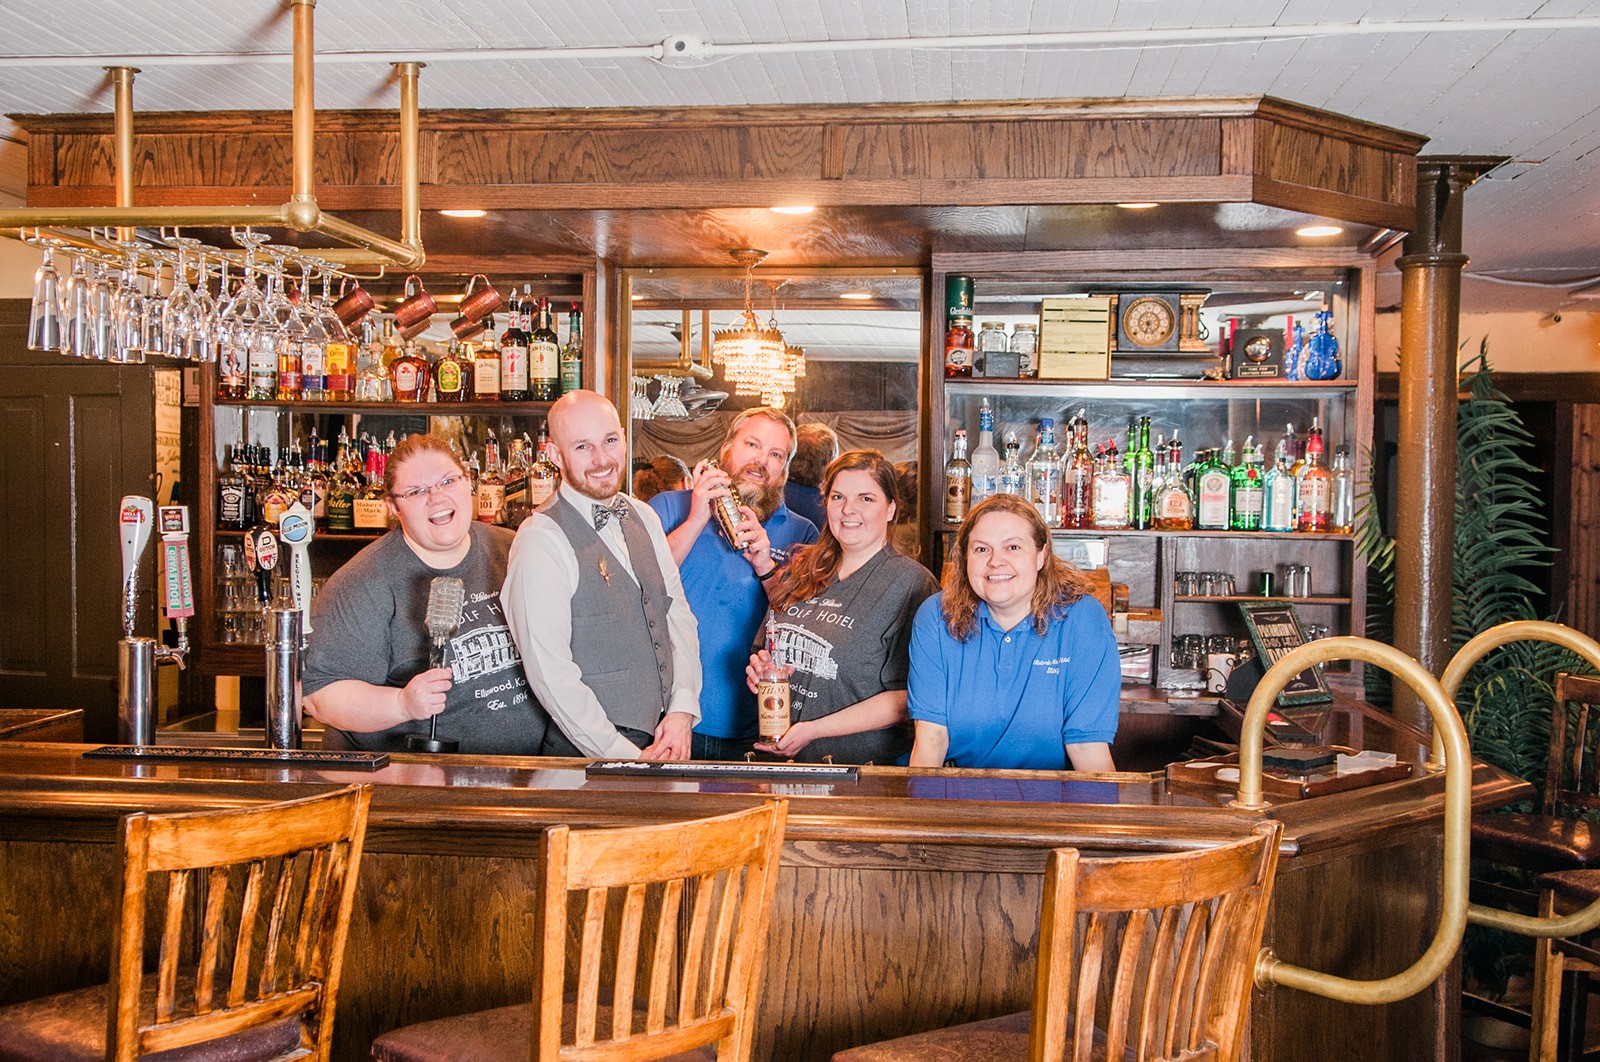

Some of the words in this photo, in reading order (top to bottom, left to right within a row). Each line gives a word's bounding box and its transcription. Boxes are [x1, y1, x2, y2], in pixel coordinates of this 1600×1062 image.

[480, 501, 492, 509] 101
[816, 610, 855, 630] HOTEL
[760, 684, 786, 695] Tito's
